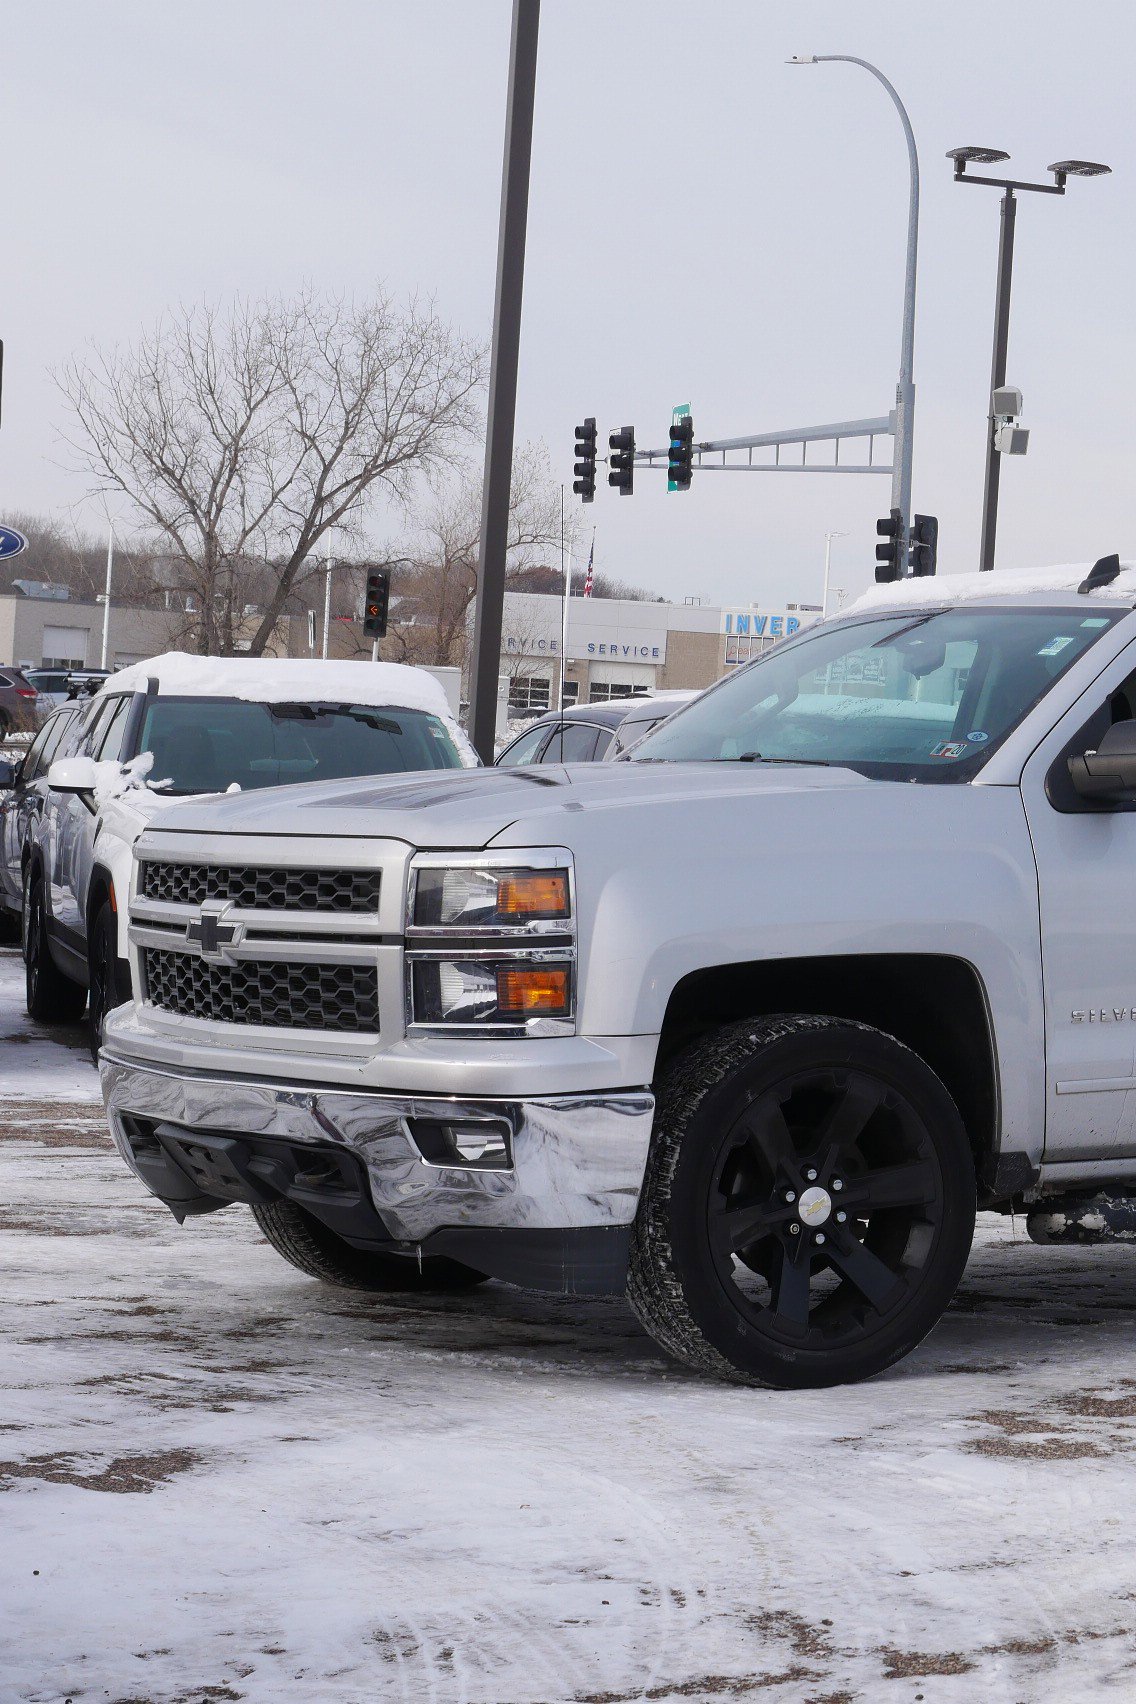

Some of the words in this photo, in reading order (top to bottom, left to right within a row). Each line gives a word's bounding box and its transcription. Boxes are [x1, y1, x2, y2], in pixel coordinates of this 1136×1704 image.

[725, 613, 800, 636] INVER
[507, 637, 558, 651] RVICE
[587, 643, 660, 658] SERVICE
